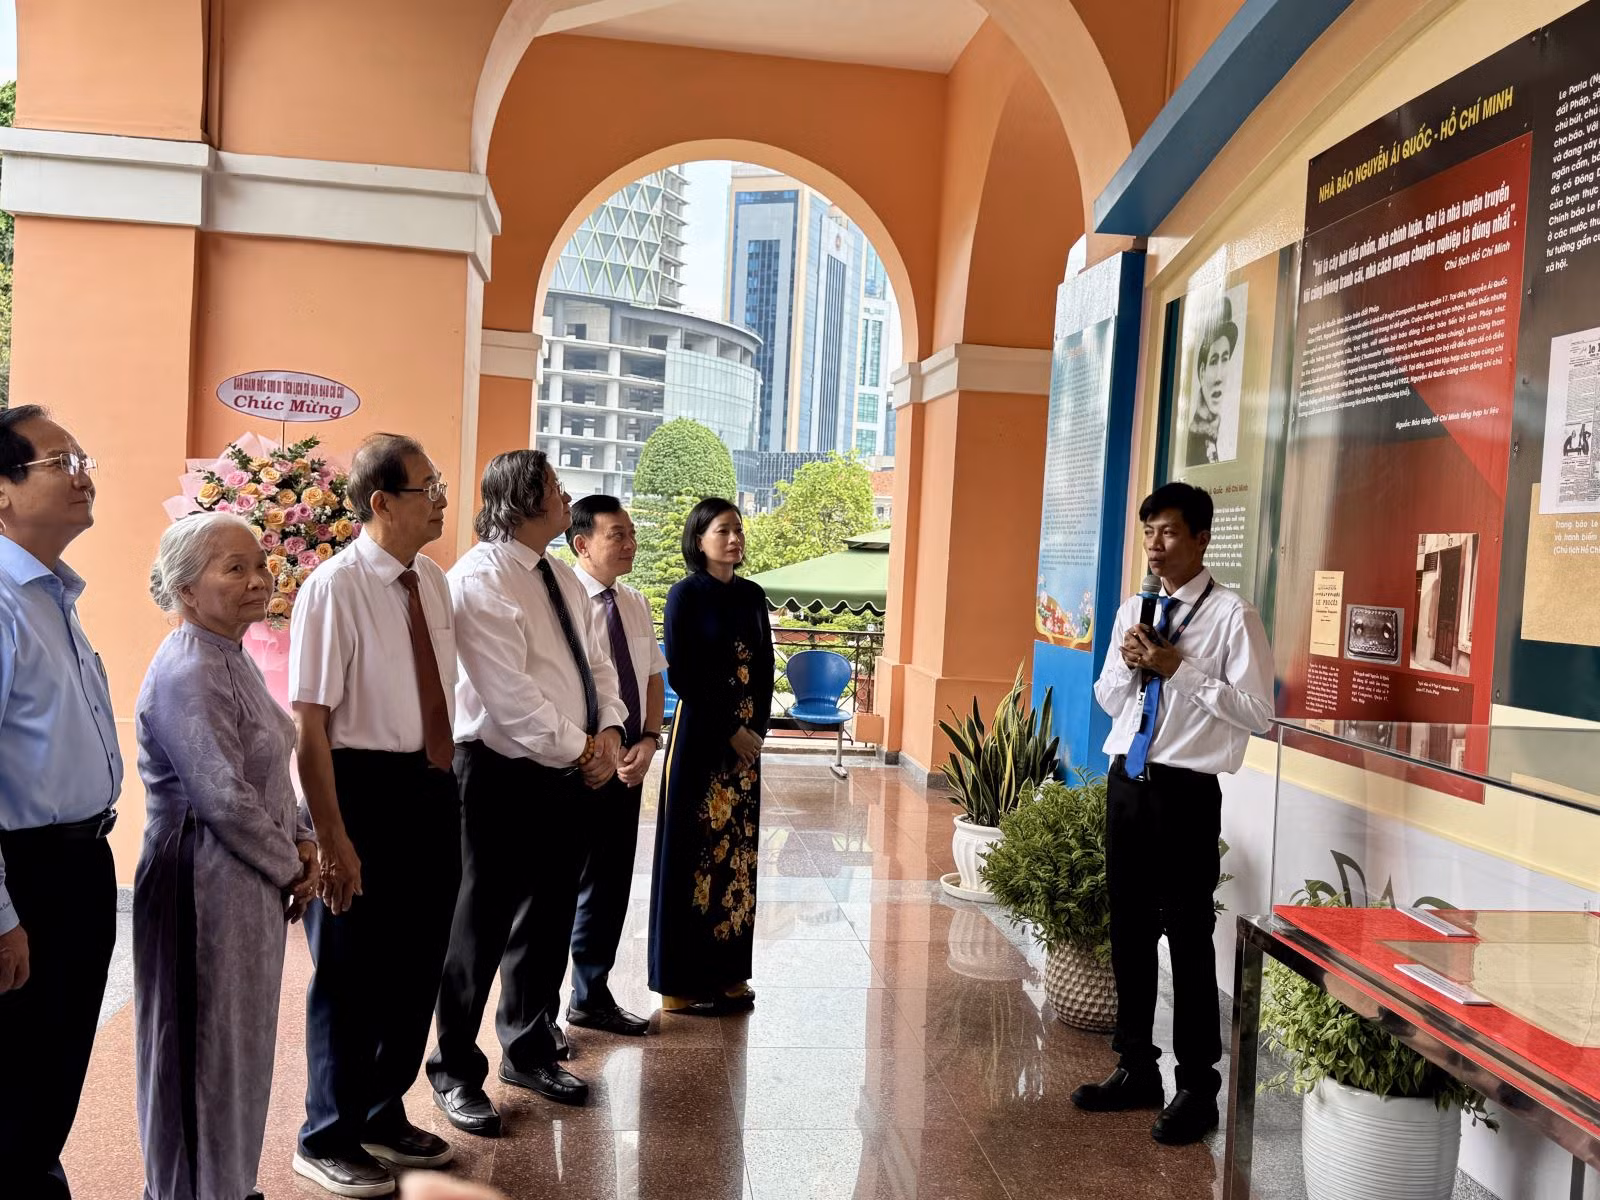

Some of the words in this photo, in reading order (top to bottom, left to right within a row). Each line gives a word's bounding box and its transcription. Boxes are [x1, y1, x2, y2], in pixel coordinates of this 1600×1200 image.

[1559, 90, 1567, 100] Le
[1569, 80, 1587, 95] Paria
[1556, 102, 1568, 117] đất
[1570, 95, 1590, 111] Pháp,
[1555, 118, 1568, 132] chủ
[1569, 113, 1583, 126] bút,
[1584, 104, 1598, 119] chủ
[1319, 176, 1334, 203] NHÀ
[1337, 168, 1353, 194] BÁO
[1355, 145, 1389, 184] NGUYỄN
[1390, 141, 1400, 165] ÁI
[1402, 122, 1432, 159] QUỐC
[1440, 106, 1456, 140] HỒ
[1460, 96, 1481, 131] CHÍ
[1482, 85, 1513, 120] MINH
[1553, 137, 1568, 148] cho
[1568, 129, 1585, 142] báo.
[1587, 121, 1599, 134] Với
[1553, 152, 1562, 163] và
[1563, 145, 1582, 159] đang
[1583, 138, 1597, 151] xảy
[1551, 166, 1570, 180] ngăn
[1571, 157, 1589, 171] cấm,
[1551, 183, 1560, 195] đó
[1562, 178, 1572, 190] có
[1574, 172, 1594, 186] Đông
[1549, 199, 1563, 210] của
[1566, 193, 1580, 205] bọn
[1582, 186, 1599, 198] thực
[1378, 232, 1389, 251] nhà
[1390, 226, 1407, 245] chính
[1408, 219, 1423, 240] luận.
[1426, 211, 1437, 233] Gọi
[1439, 208, 1445, 226] là
[1447, 202, 1460, 223] nhà
[1462, 194, 1483, 217] tuyên
[1485, 180, 1509, 209] truyền
[1548, 211, 1569, 226] Chính
[1571, 206, 1585, 219] báo
[1587, 203, 1595, 213] Le
[1547, 231, 1552, 242] ở
[1554, 228, 1567, 240] các
[1569, 221, 1588, 235] nước
[1365, 261, 1376, 280] nhà
[1377, 256, 1392, 275] cách
[1393, 250, 1410, 271] mạng
[1411, 239, 1435, 262] chuyên
[1437, 230, 1461, 254] nghiệp
[1463, 225, 1470, 244] là
[1472, 220, 1490, 241] đúng
[1445, 257, 1457, 271] Chủ
[1458, 254, 1470, 269] tịch
[1471, 247, 1481, 262] Hồ
[1482, 244, 1494, 258] Chí
[1494, 241, 1510, 255] Minh
[1546, 247, 1554, 257] tư
[1555, 241, 1575, 255] tưởng
[1577, 234, 1591, 250] gắn
[1545, 262, 1554, 273] xã
[1555, 258, 1568, 271] hội.
[1479, 308, 1492, 316] Pháp
[234, 395, 285, 411] Chúc
[289, 399, 342, 419] Mừng
